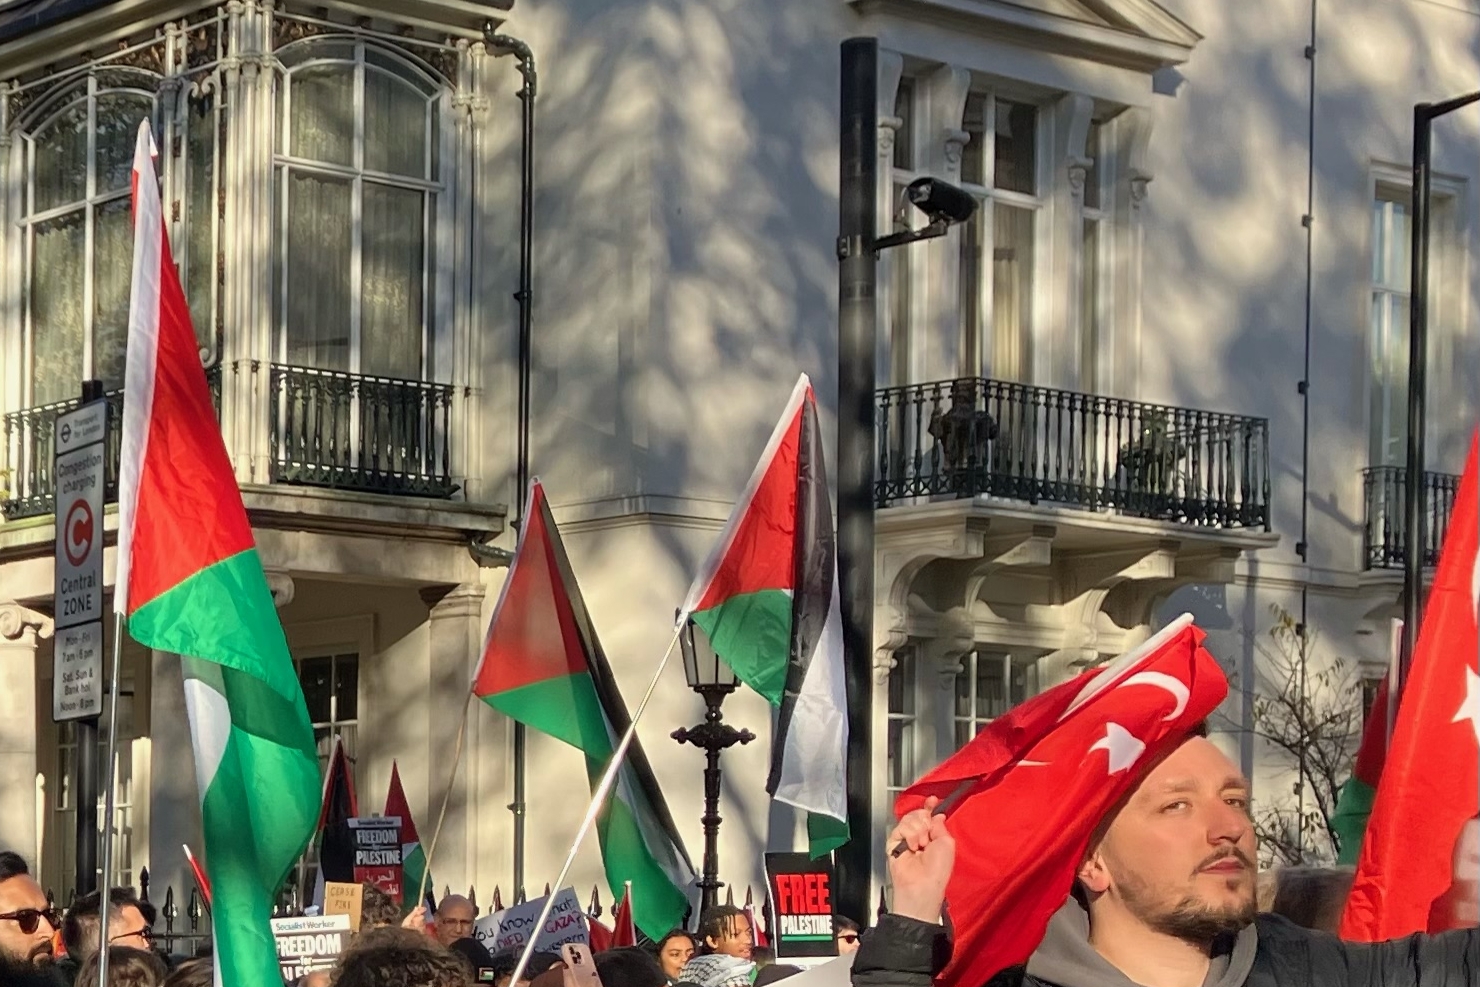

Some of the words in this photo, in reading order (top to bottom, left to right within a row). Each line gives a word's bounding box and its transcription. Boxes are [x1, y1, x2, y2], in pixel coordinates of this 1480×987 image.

[59, 454, 101, 477] Congestion
[63, 474, 95, 494] charging
[61, 570, 96, 594] Central
[64, 594, 92, 616] ZONE
[356, 829, 397, 844] FREEDOM
[356, 850, 401, 865] PALESTINE
[776, 874, 831, 914] FREE
[275, 921, 305, 931] Socialist
[306, 919, 335, 929] Worker
[781, 915, 833, 935] PALESTINE
[275, 933, 342, 957] FREEDOM
